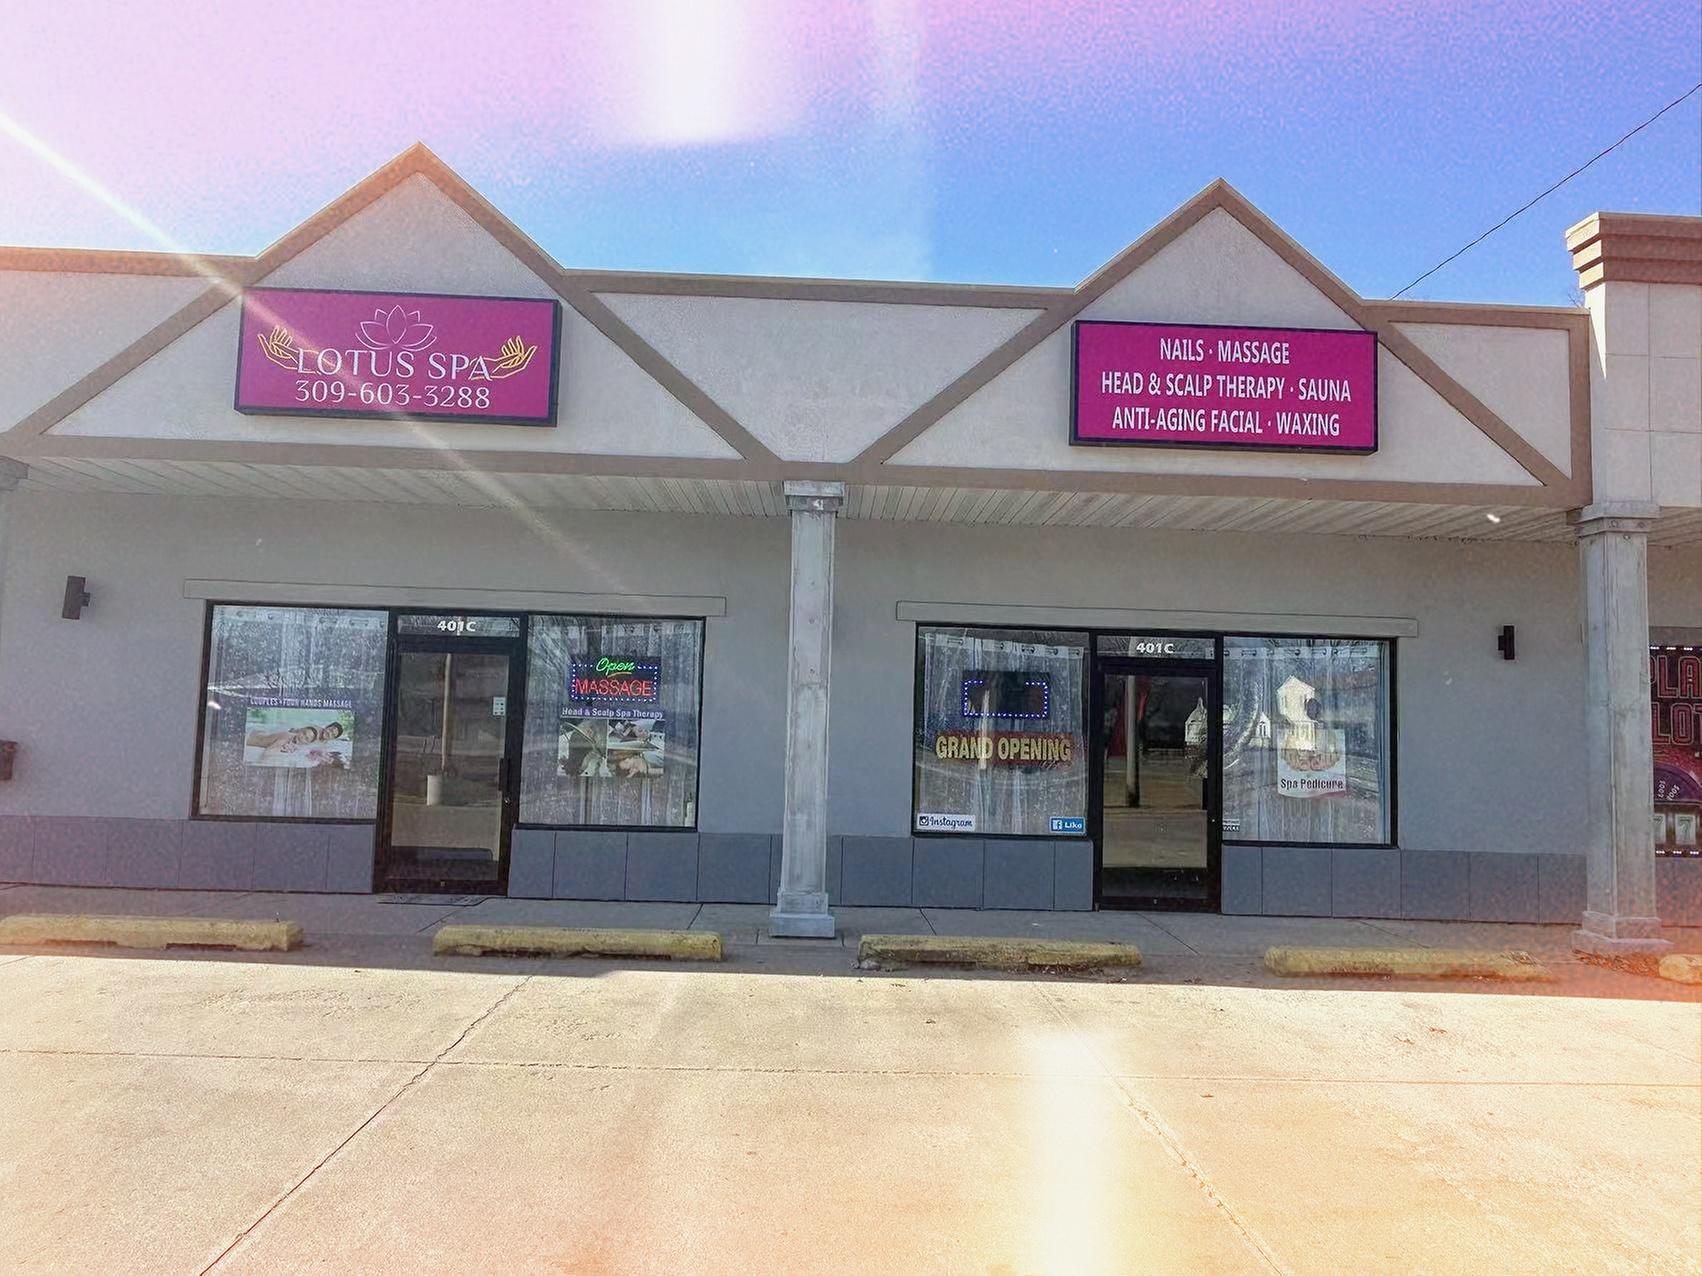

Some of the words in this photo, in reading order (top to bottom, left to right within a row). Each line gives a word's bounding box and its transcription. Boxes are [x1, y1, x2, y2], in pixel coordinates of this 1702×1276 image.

[1160, 337, 1204, 362] NAILS
[1217, 340, 1290, 364] MASSAGE
[297, 347, 415, 378] LOTUS
[428, 352, 493, 381] SPA
[294, 379, 491, 409] 309-603-3288
[1101, 371, 1143, 395] HEAD
[1148, 373, 1161, 395] &
[1166, 373, 1212, 397] SCALP
[1216, 374, 1285, 399] THERAPY
[1299, 378, 1351, 402] SAUNA
[1112, 406, 1205, 432] ANTI-AGING
[1211, 409, 1263, 433] FACIAL
[1276, 411, 1340, 436] WAXING
[437, 620, 477, 632] 401C
[1136, 642, 1175, 654] 401C
[595, 657, 635, 676] Open
[575, 678, 653, 697] MASSAGE
[323, 700, 352, 709] MASSAGE
[562, 707, 583, 716] Head
[591, 707, 615, 718] Scalp
[616, 709, 631, 719] Spa
[633, 709, 663, 720] Therapy
[935, 735, 993, 759] GRAND
[998, 737, 1073, 761] OPENING
[1280, 778, 1298, 790] Spa
[1300, 778, 1343, 790] Pedicure
[928, 815, 973, 832] Instagram
[1064, 821, 1083, 831] Like
